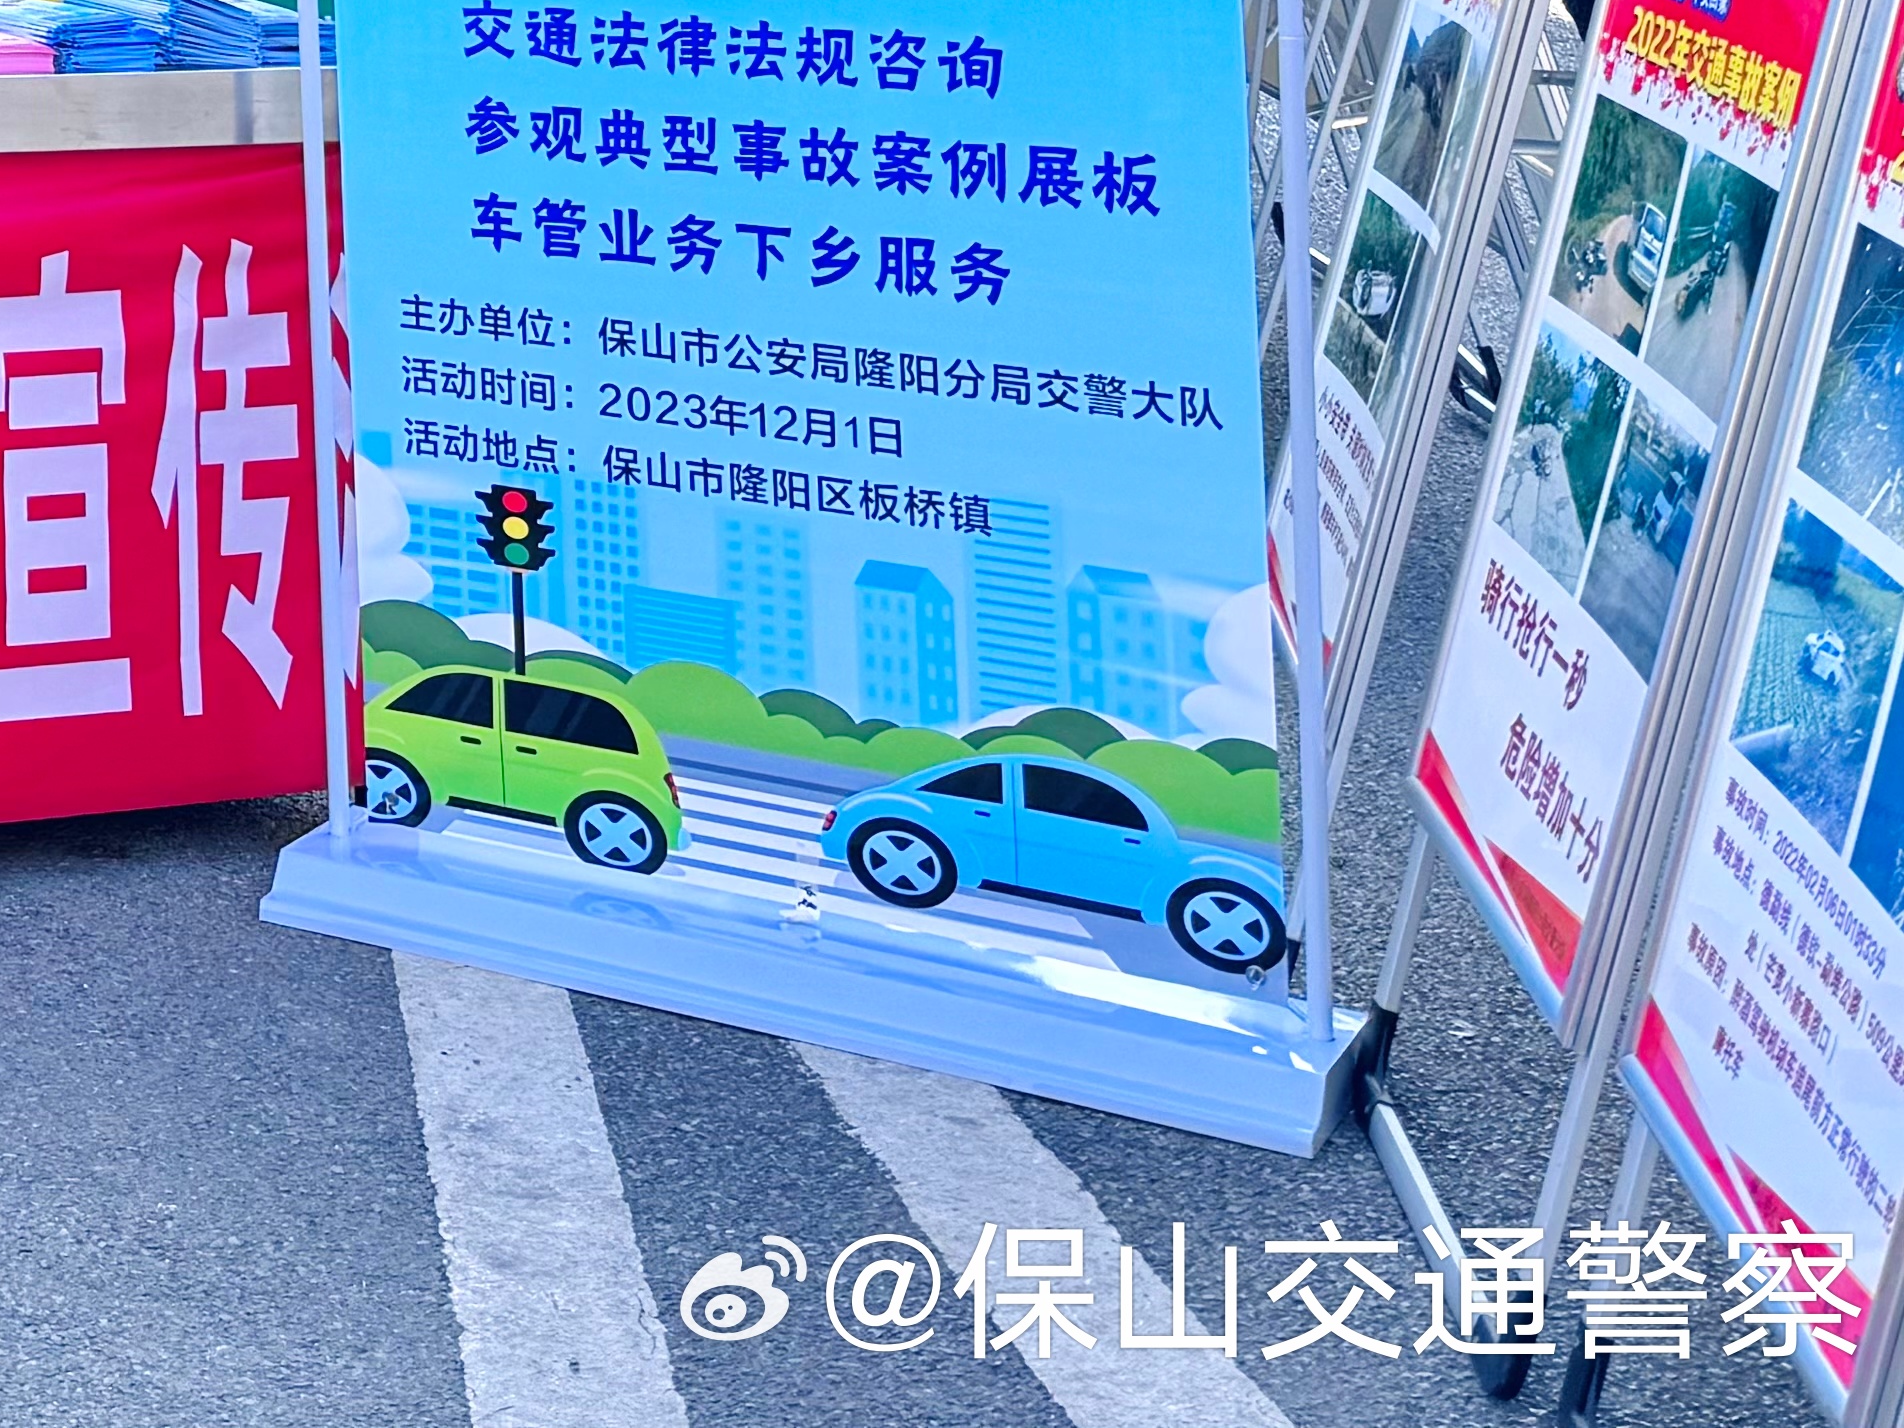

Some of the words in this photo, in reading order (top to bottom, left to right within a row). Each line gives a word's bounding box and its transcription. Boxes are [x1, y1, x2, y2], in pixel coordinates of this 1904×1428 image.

[461, 0, 1006, 100] 交通法律法规咨询
[1624, 6, 1803, 130] 2022年交通事故案例
[464, 97, 1162, 217] 参观典型事故案例展板
[470, 191, 1012, 307] 车管业务下乡服务
[399, 295, 1224, 432] 主办单位：保山市公安局隆阳分局交警大队
[400, 355, 905, 460] 活动时间：2023年12月1日
[403, 416, 995, 539] 活动地点：保山市隆阳区板桥镇
[1480, 557, 1591, 712] 骑行抢行一秒
[1712, 1025, 1744, 1081] 摩托车
